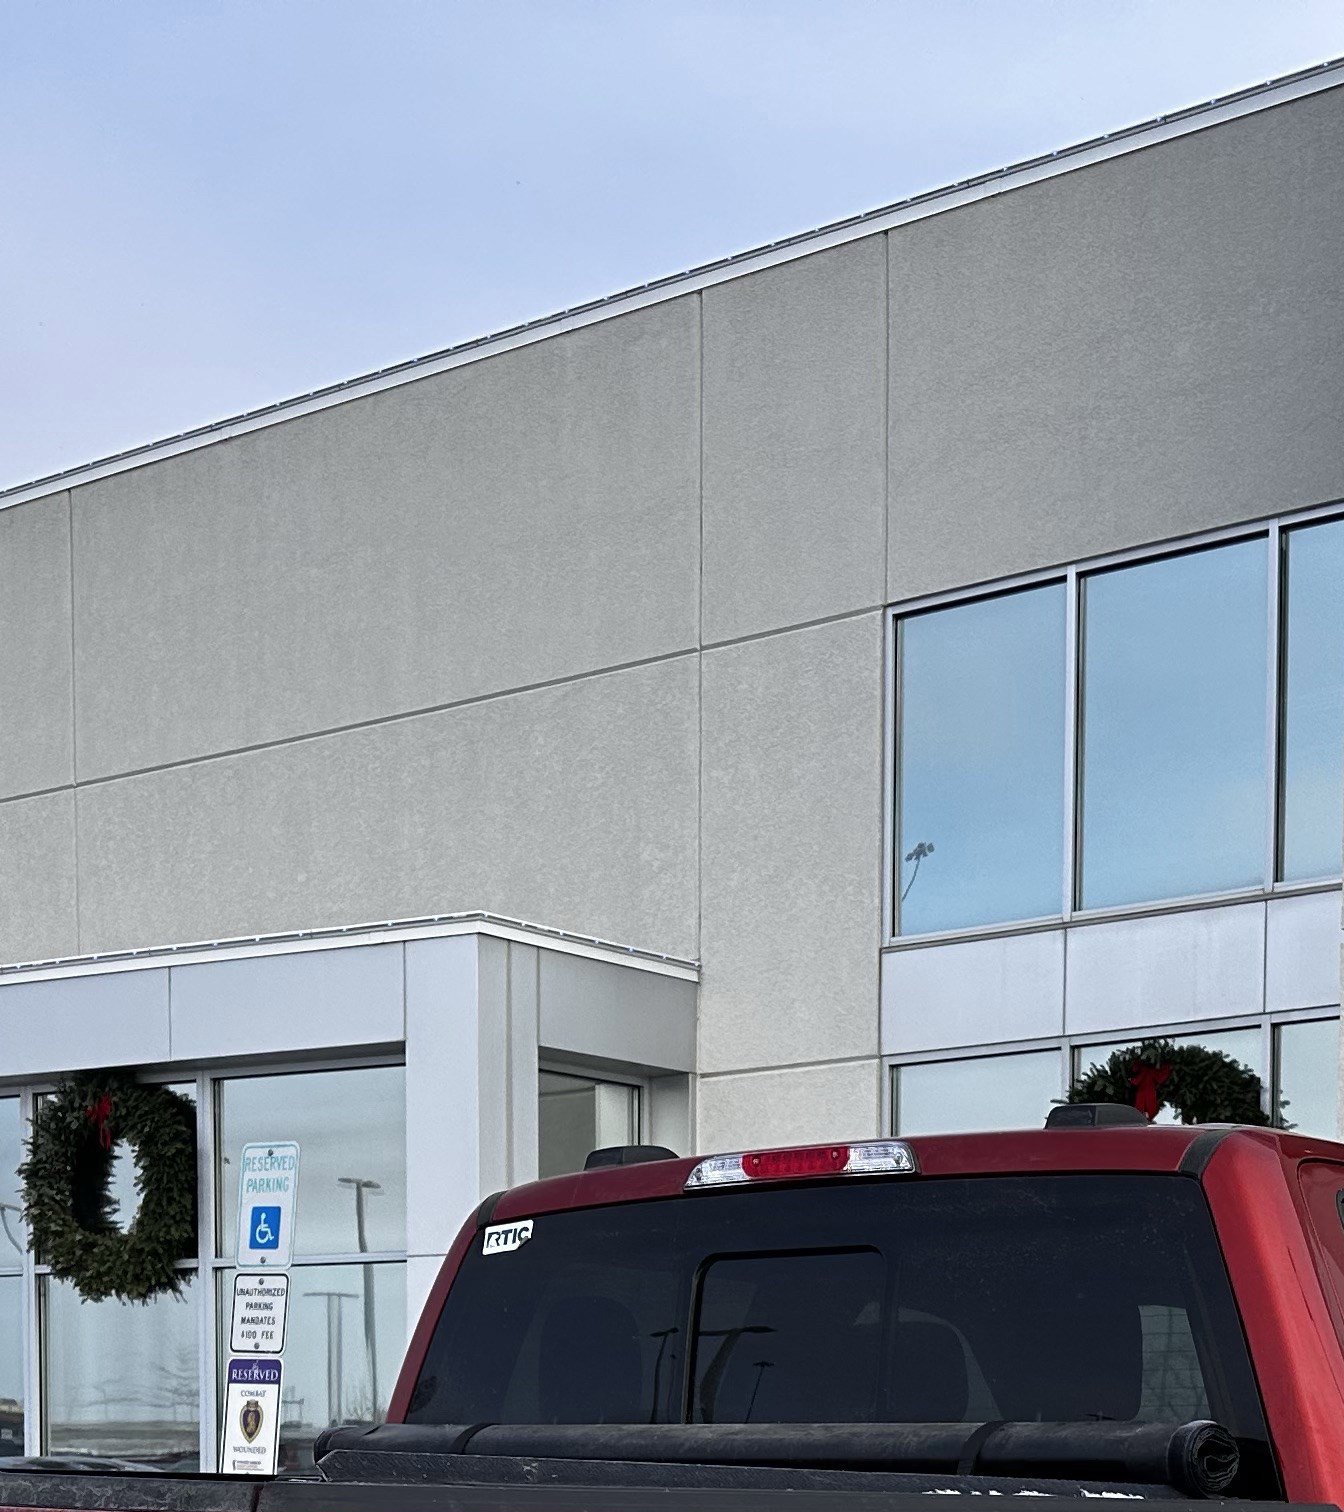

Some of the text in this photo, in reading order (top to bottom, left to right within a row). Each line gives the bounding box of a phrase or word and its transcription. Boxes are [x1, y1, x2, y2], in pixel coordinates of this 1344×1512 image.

[244, 1155, 295, 1172] RESERVED
[246, 1177, 290, 1193] PARKING
[486, 1226, 530, 1248] RTIC
[236, 1287, 286, 1297] UNAUTHORIZED
[245, 1301, 274, 1311] PARKING
[240, 1315, 276, 1326] MANDATES
[261, 1331, 274, 1340] FEE
[231, 1369, 279, 1381] RESERVED
